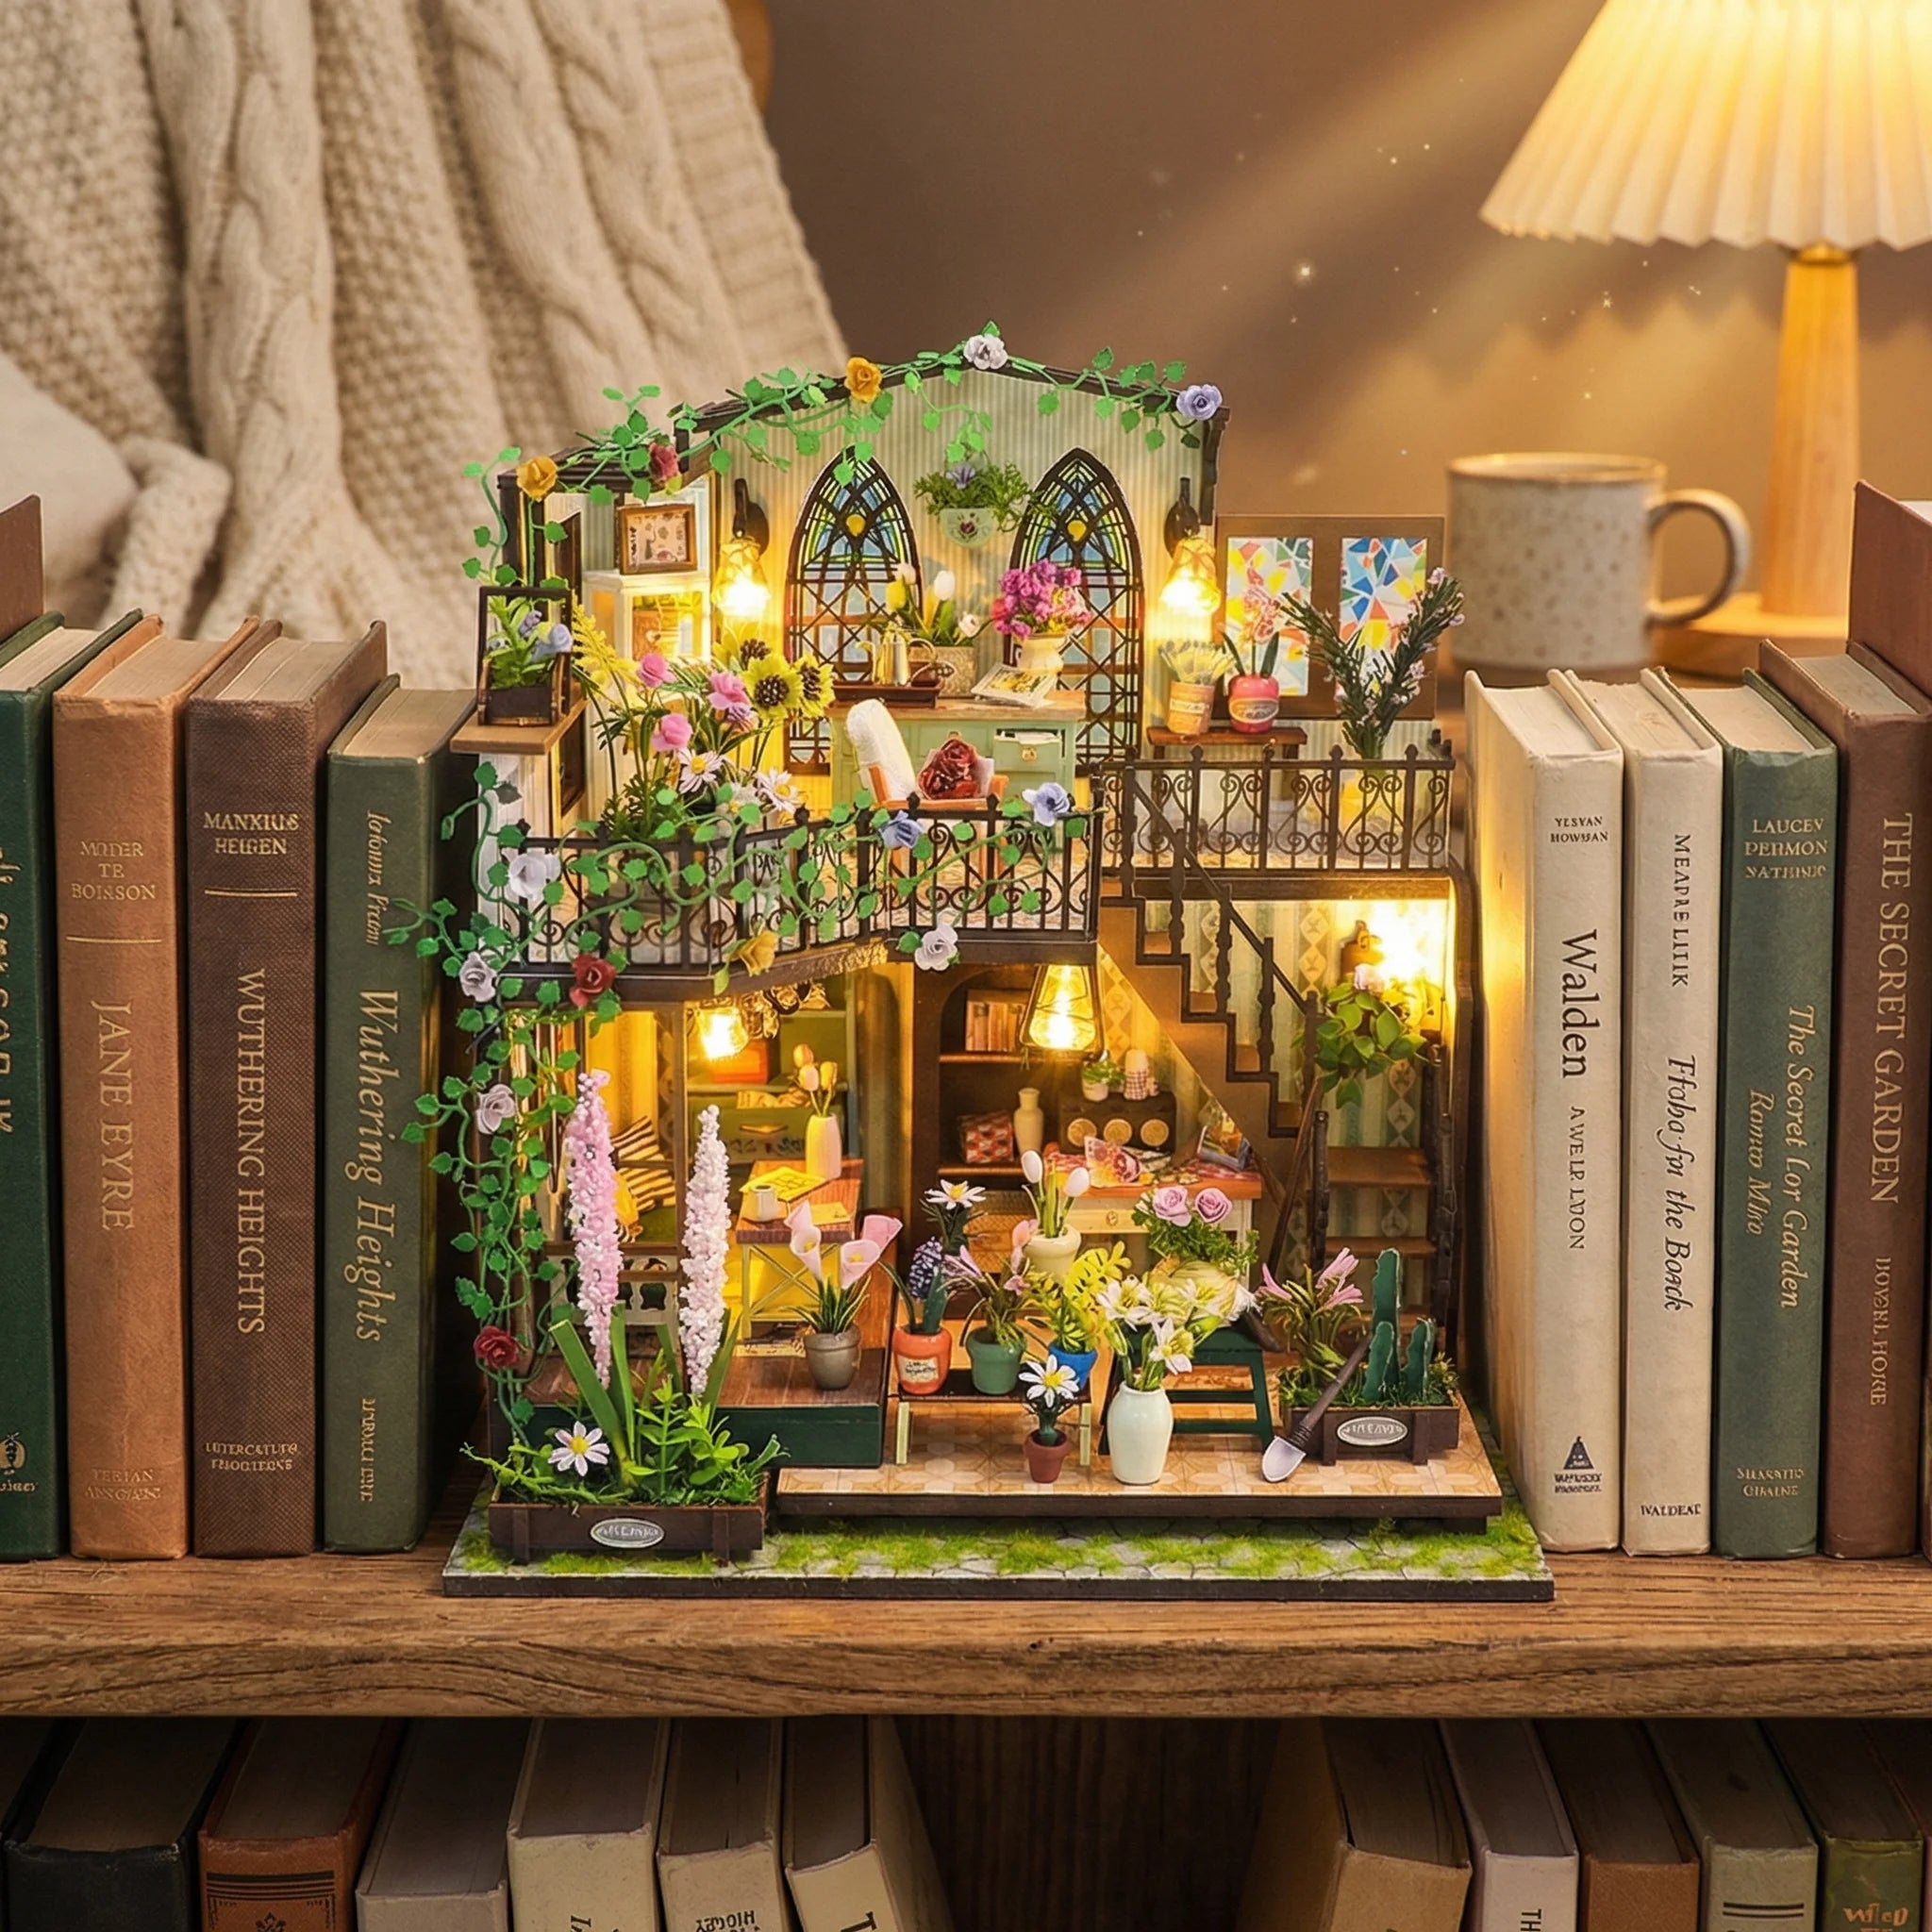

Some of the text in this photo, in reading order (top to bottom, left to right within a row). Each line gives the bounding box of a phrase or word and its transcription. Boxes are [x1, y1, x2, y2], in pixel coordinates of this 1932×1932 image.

[1561, 927, 1601, 1079] Walden
[1787, 1004, 1817, 1056] The
[1870, 811, 1913, 1204] THE SECRET GARDEN
[90, 1000, 136, 1231] JANE EYRE
[236, 968, 267, 1334] WUTHERING HEIGHTS
[342, 990, 400, 1341] Wuthering Heights
[1784, 1062, 1815, 1148] Secret
[1664, 1189, 1696, 1230] the
[1780, 1209, 1809, 1309] Garden
